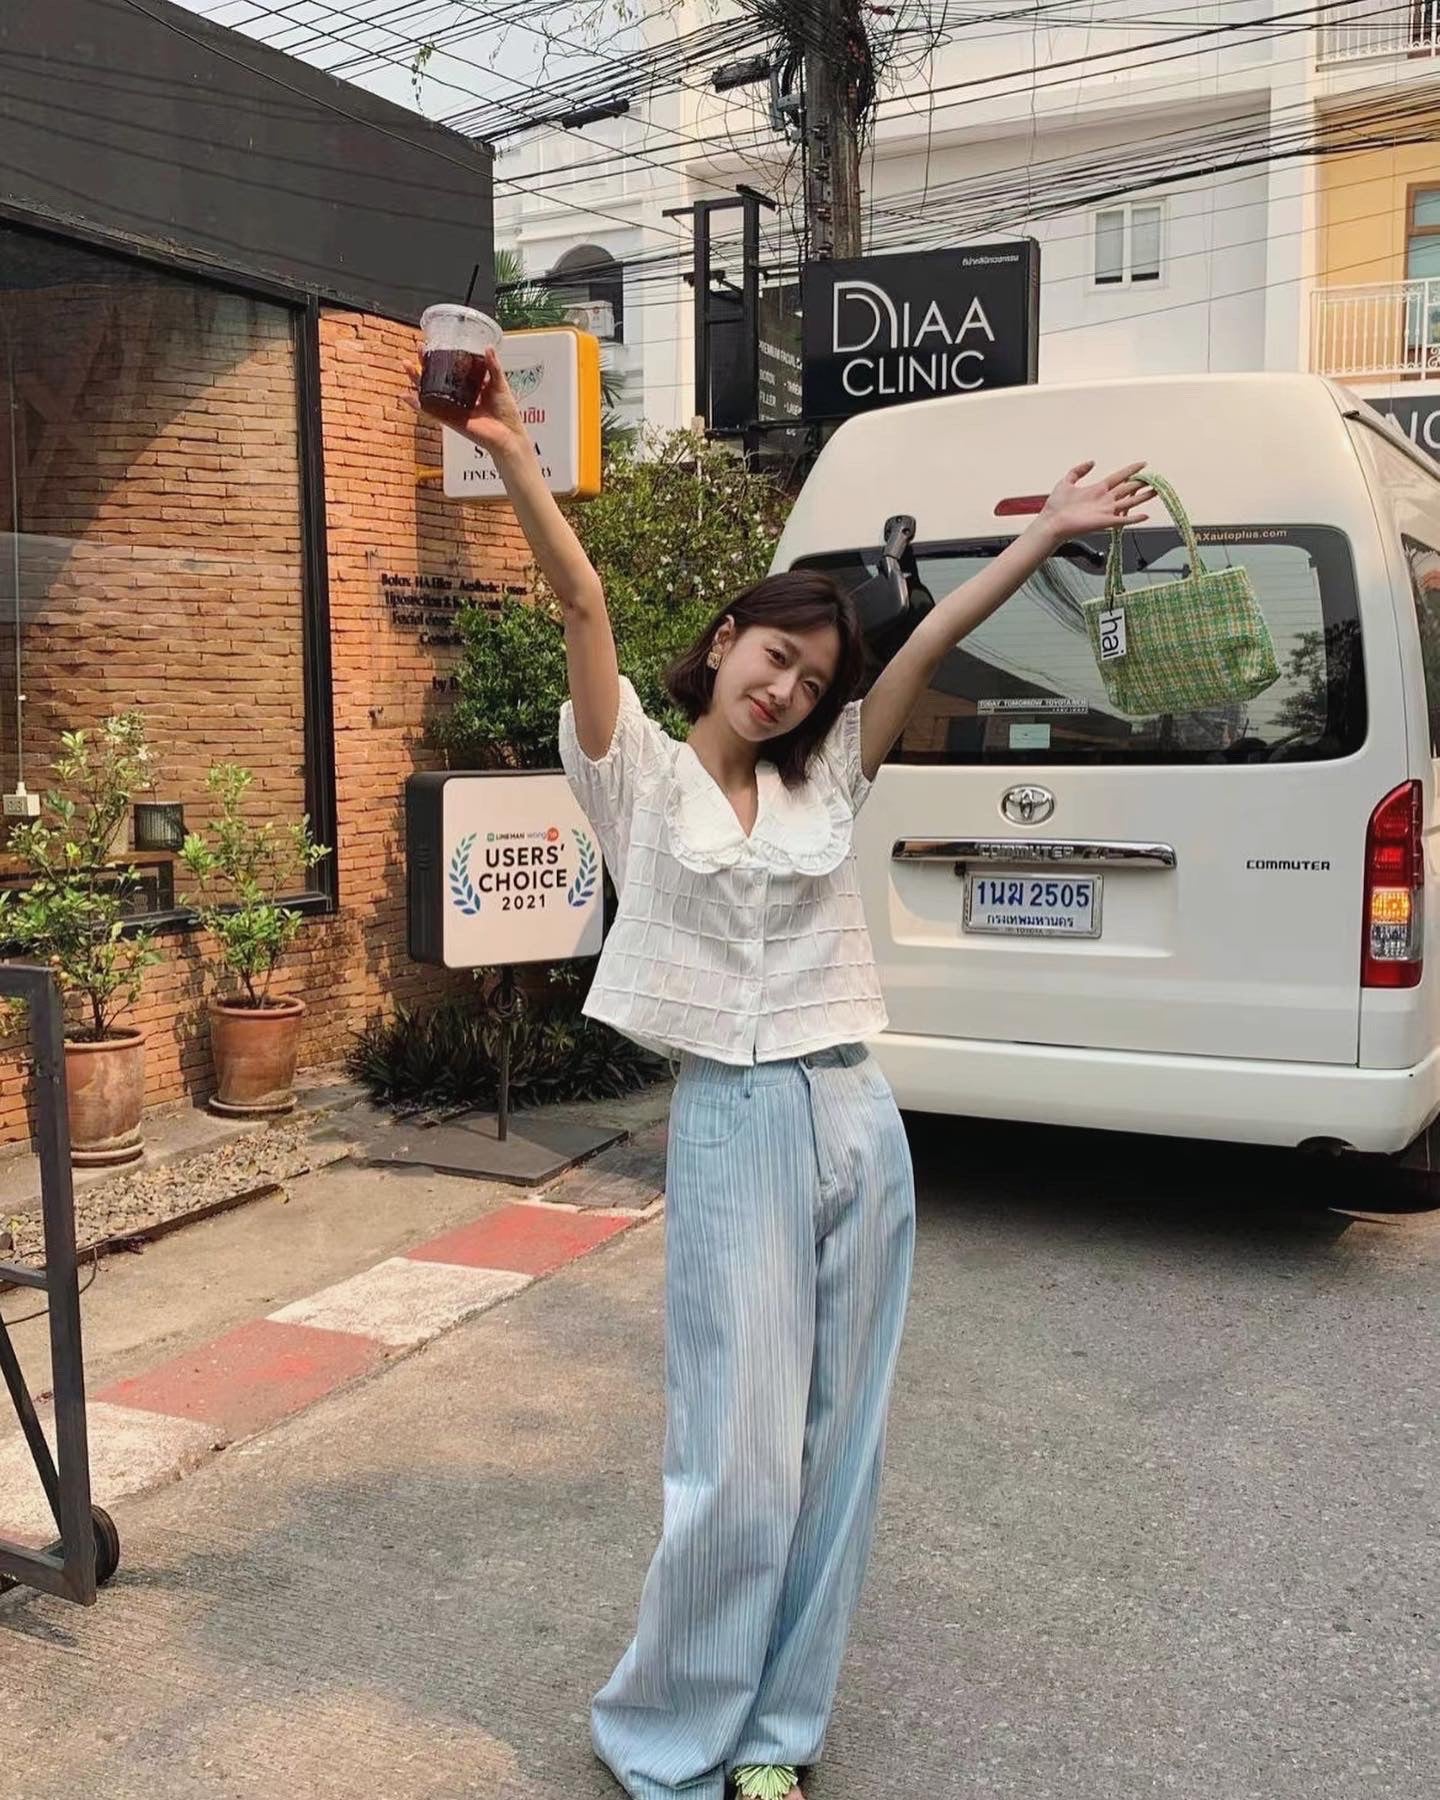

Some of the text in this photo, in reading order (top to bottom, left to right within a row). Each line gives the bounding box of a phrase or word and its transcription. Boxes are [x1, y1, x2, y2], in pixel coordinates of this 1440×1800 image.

[833, 280, 995, 353] DIAA
[842, 351, 985, 396] CLINIC
[1101, 615, 1124, 659] hai
[486, 843, 565, 867] USERS'
[479, 869, 567, 892] CHOICE
[502, 894, 545, 911] 2021
[1030, 883, 1090, 907] 2505
[987, 914, 1074, 928] กรุงเทพมหานคร
